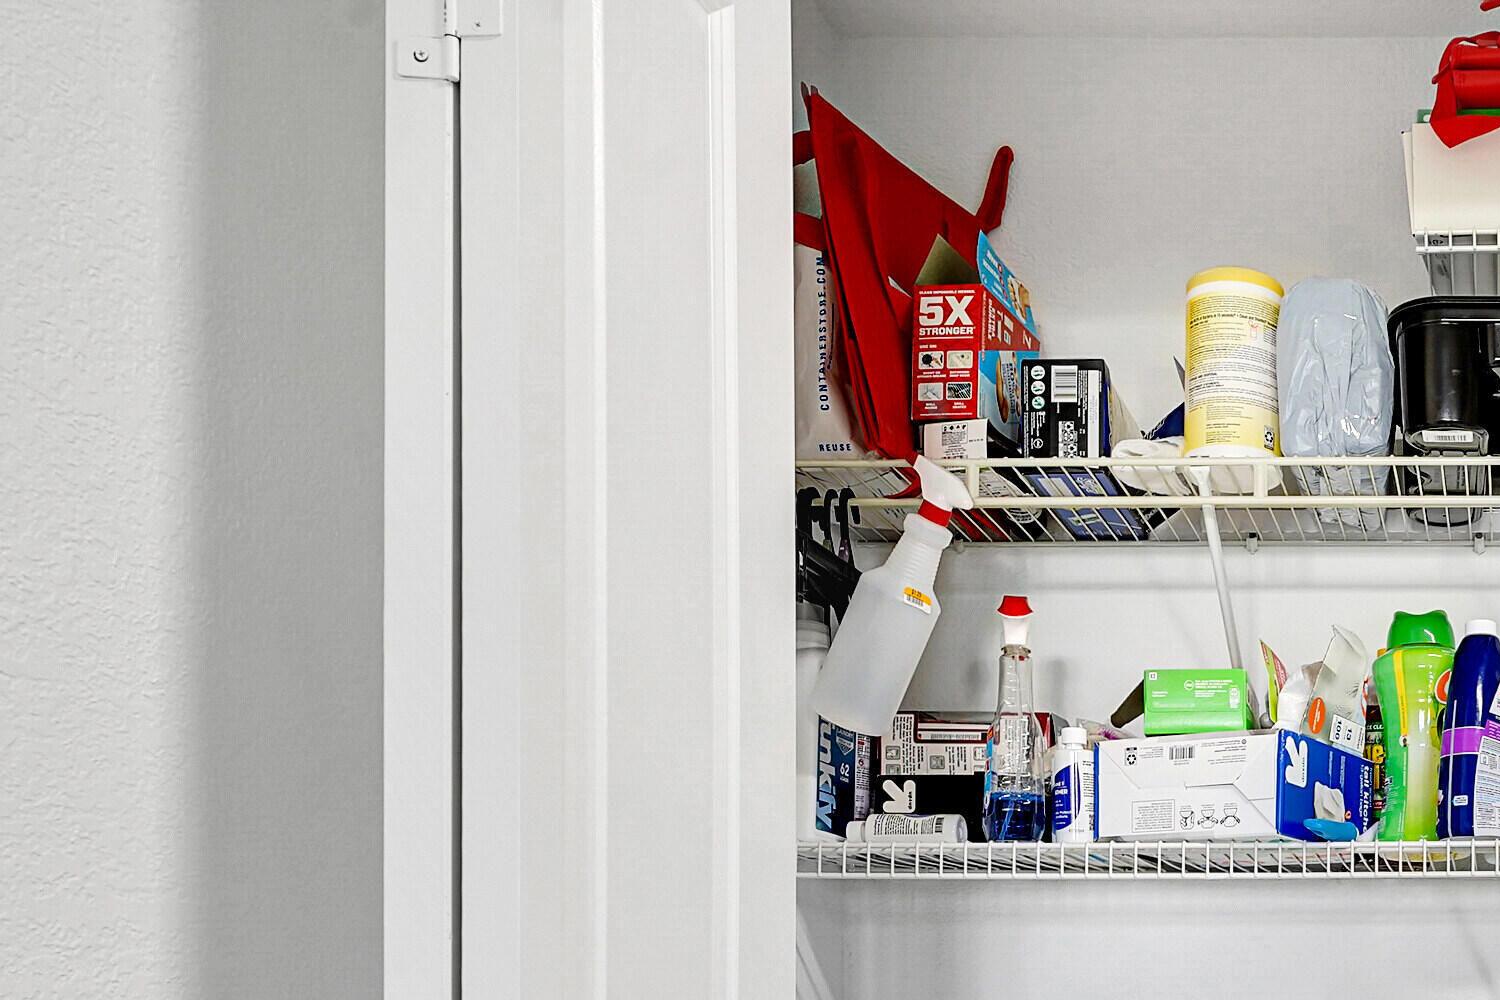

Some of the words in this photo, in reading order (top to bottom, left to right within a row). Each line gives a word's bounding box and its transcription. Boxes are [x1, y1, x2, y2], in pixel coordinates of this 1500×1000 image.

[919, 296, 974, 326] 5X
[815, 256, 830, 411] CONTAINERSTORE.COM
[919, 326, 974, 336] STRONGER
[819, 443, 852, 452] REUSE
[816, 721, 837, 830] unkify
[840, 762, 850, 777] 62
